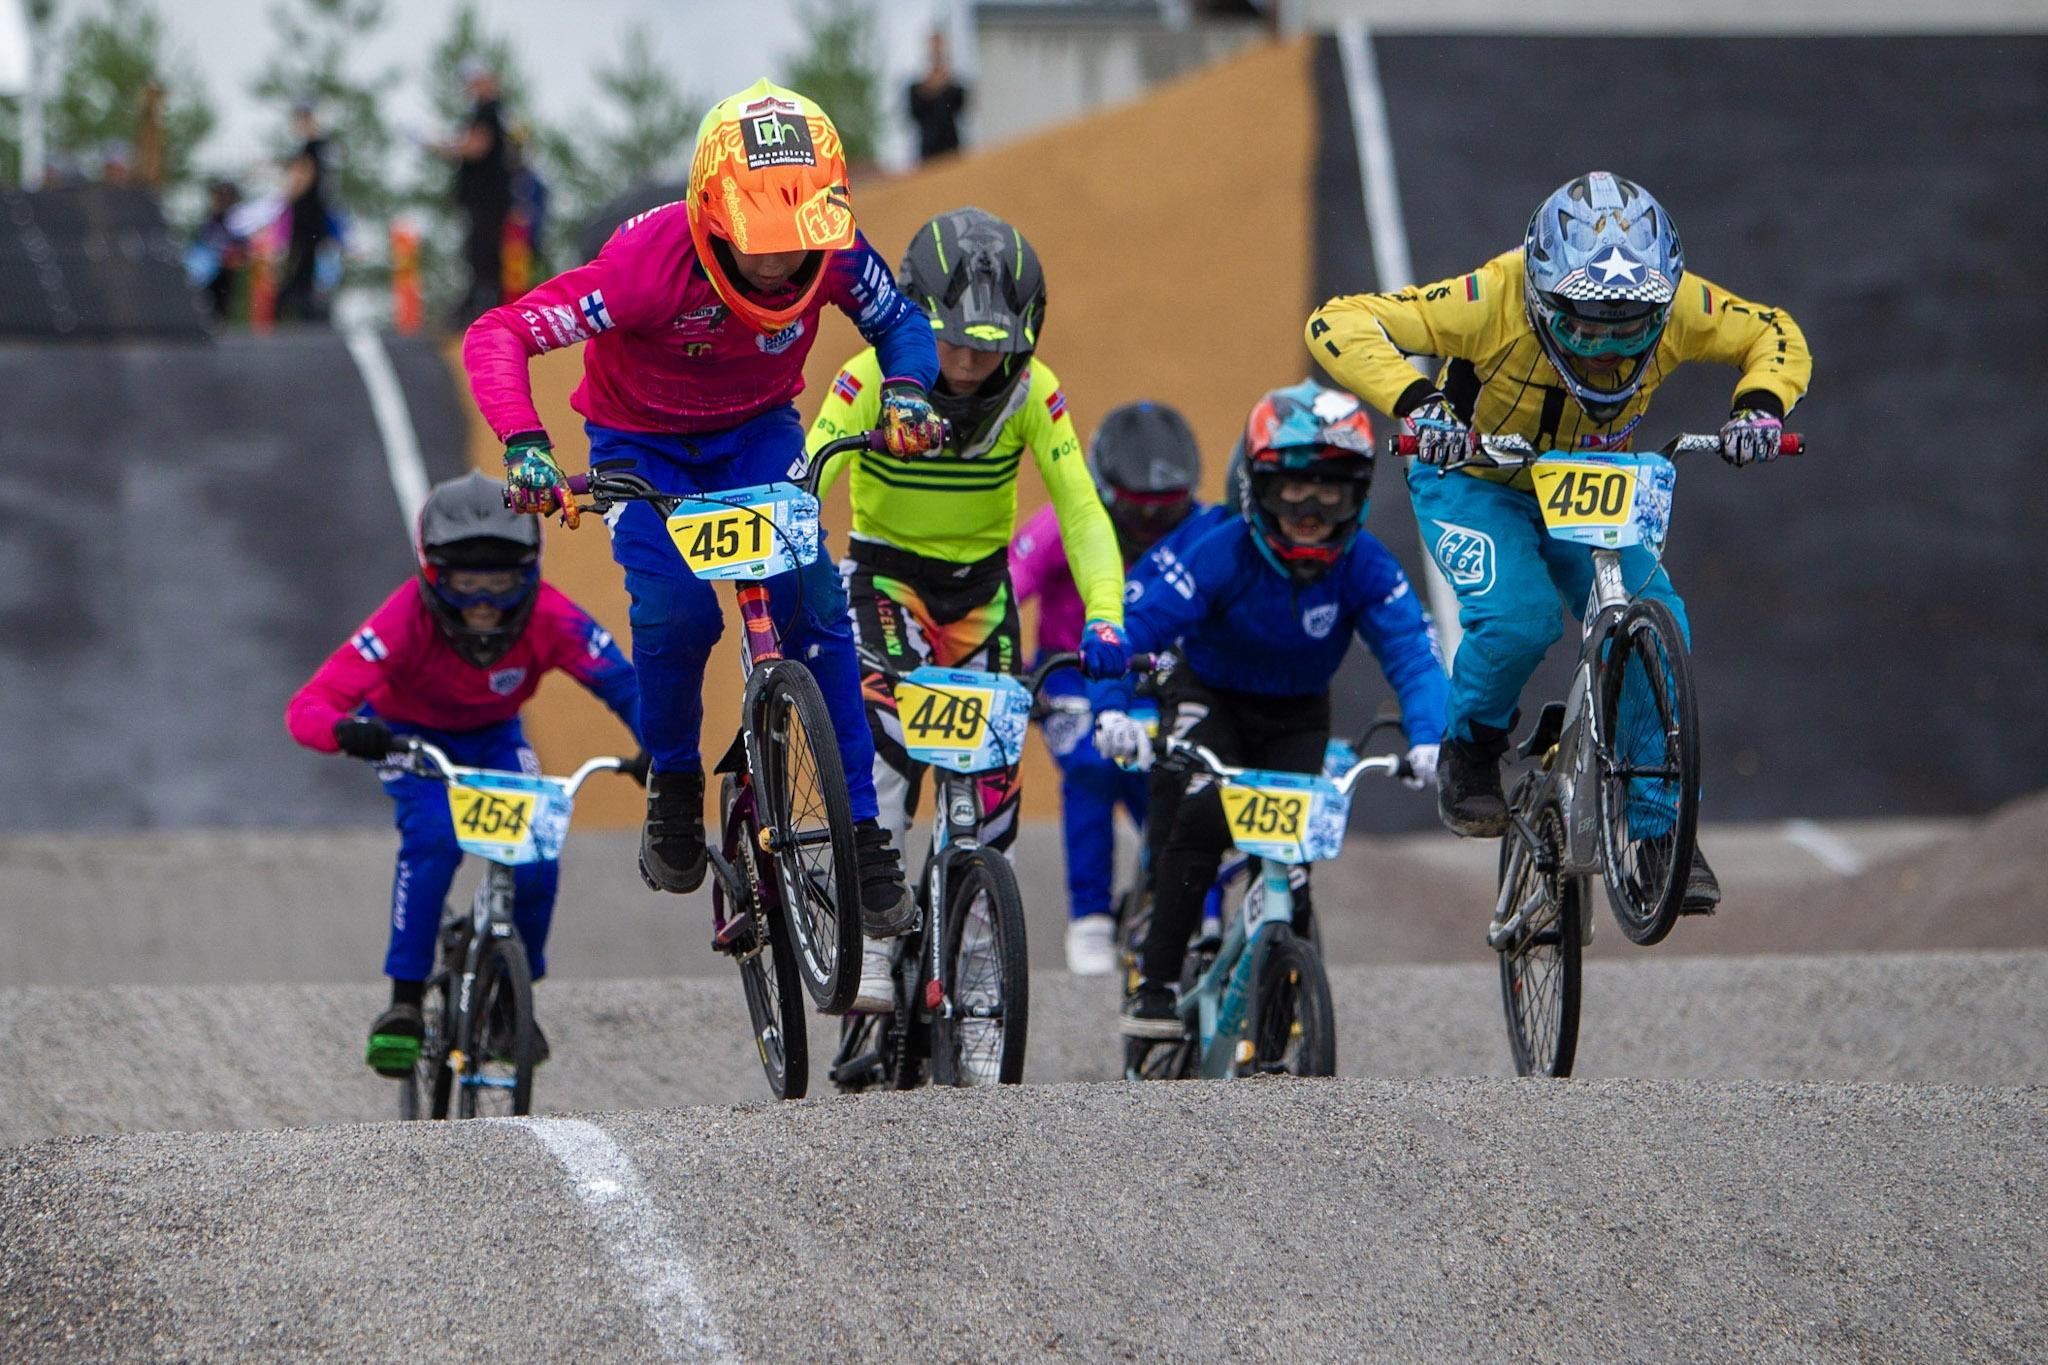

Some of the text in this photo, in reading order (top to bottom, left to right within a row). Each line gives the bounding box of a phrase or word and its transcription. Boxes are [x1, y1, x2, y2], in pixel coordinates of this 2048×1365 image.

[1547, 472, 1627, 517] 450
[690, 514, 762, 561] 451
[908, 694, 983, 740] 449
[462, 797, 525, 835] 454
[1236, 797, 1300, 834] 453
